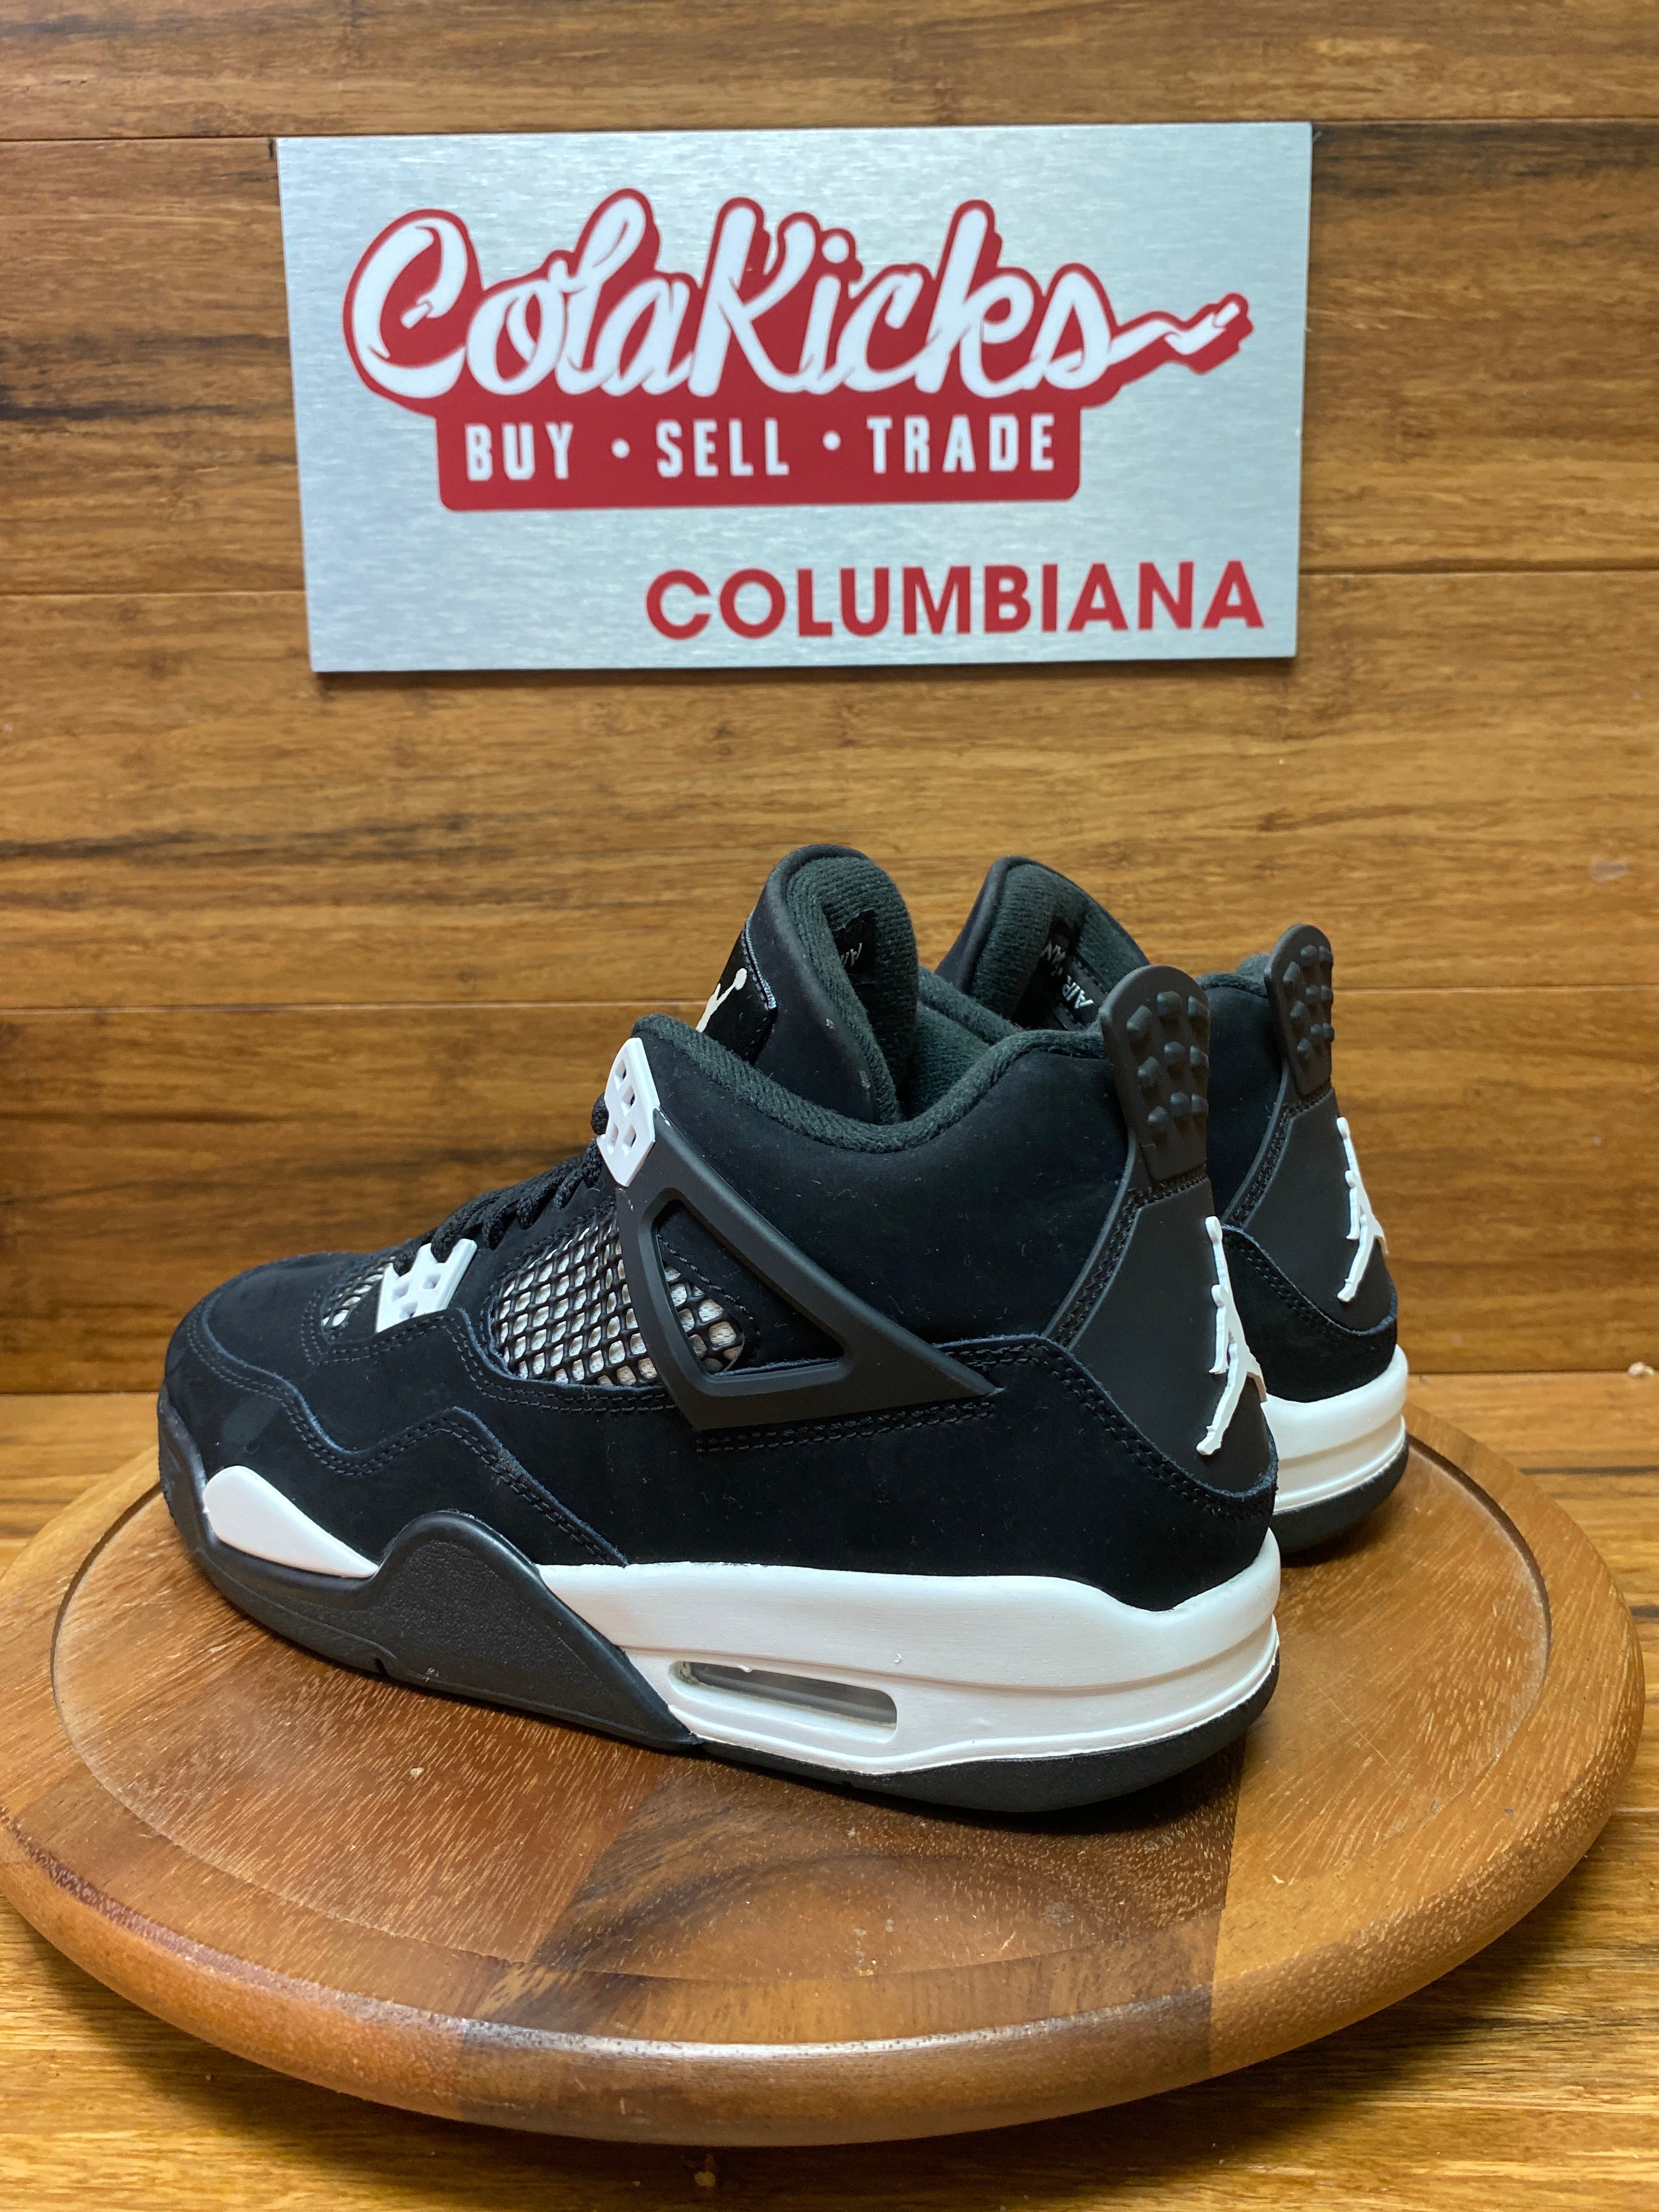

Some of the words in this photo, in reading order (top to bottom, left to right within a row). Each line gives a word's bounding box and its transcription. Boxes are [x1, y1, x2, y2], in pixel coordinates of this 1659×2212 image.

[352, 195, 1241, 399] ColaKicks
[465, 422, 573, 481] BUY
[656, 418, 789, 477] SELL
[867, 414, 1054, 473] TRADE
[647, 561, 1262, 639] COLUMBIANA
[1062, 975, 1094, 1009] AIR
